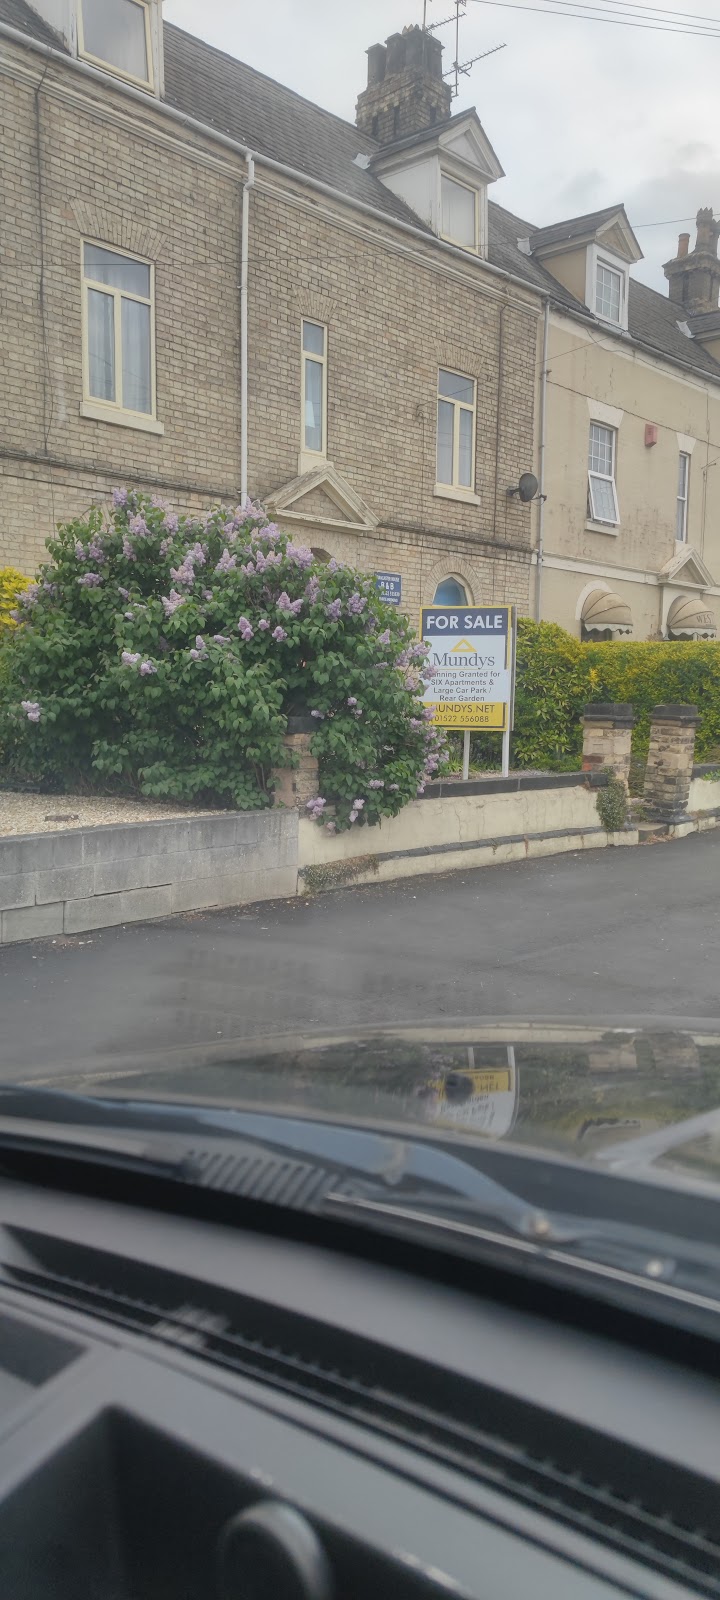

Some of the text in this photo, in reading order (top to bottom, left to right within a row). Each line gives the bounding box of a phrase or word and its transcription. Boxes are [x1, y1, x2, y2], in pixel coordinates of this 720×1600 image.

[426, 615, 503, 629] FOR SALE
[432, 653, 495, 669] Mundys
